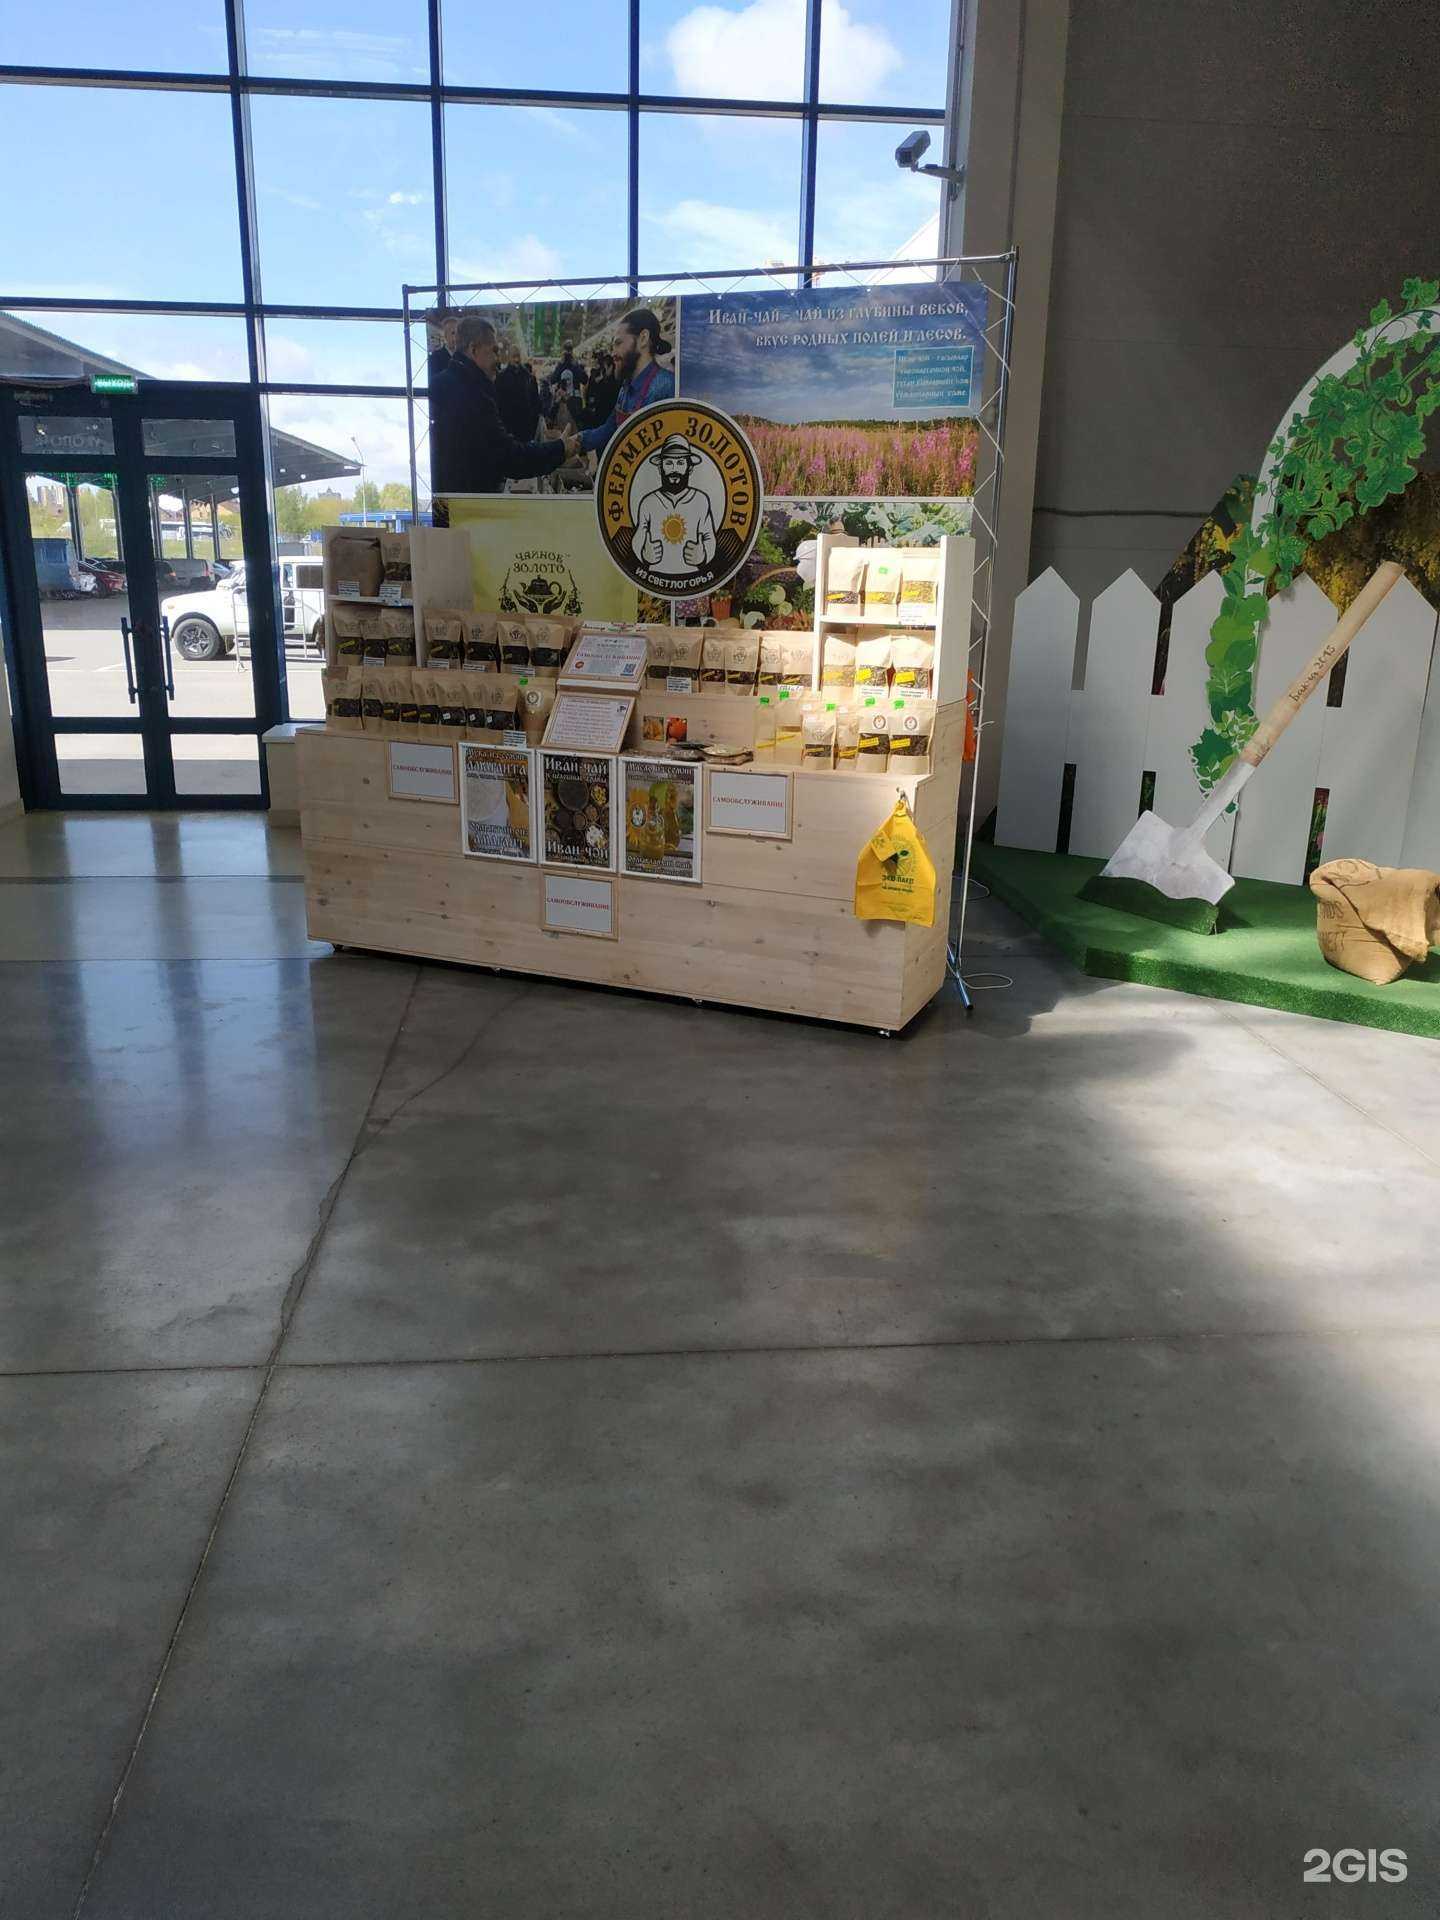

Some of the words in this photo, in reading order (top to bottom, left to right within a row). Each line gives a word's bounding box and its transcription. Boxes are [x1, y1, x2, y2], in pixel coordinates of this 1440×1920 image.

[607, 419, 664, 522] ФЕРМЕР
[684, 416, 750, 526] ЗОЛОТОВ
[513, 561, 565, 574] ЗОЛОТО
[635, 567, 647, 579] ИЗ
[647, 570, 715, 589] СВЕТЛОГОРЬЯ
